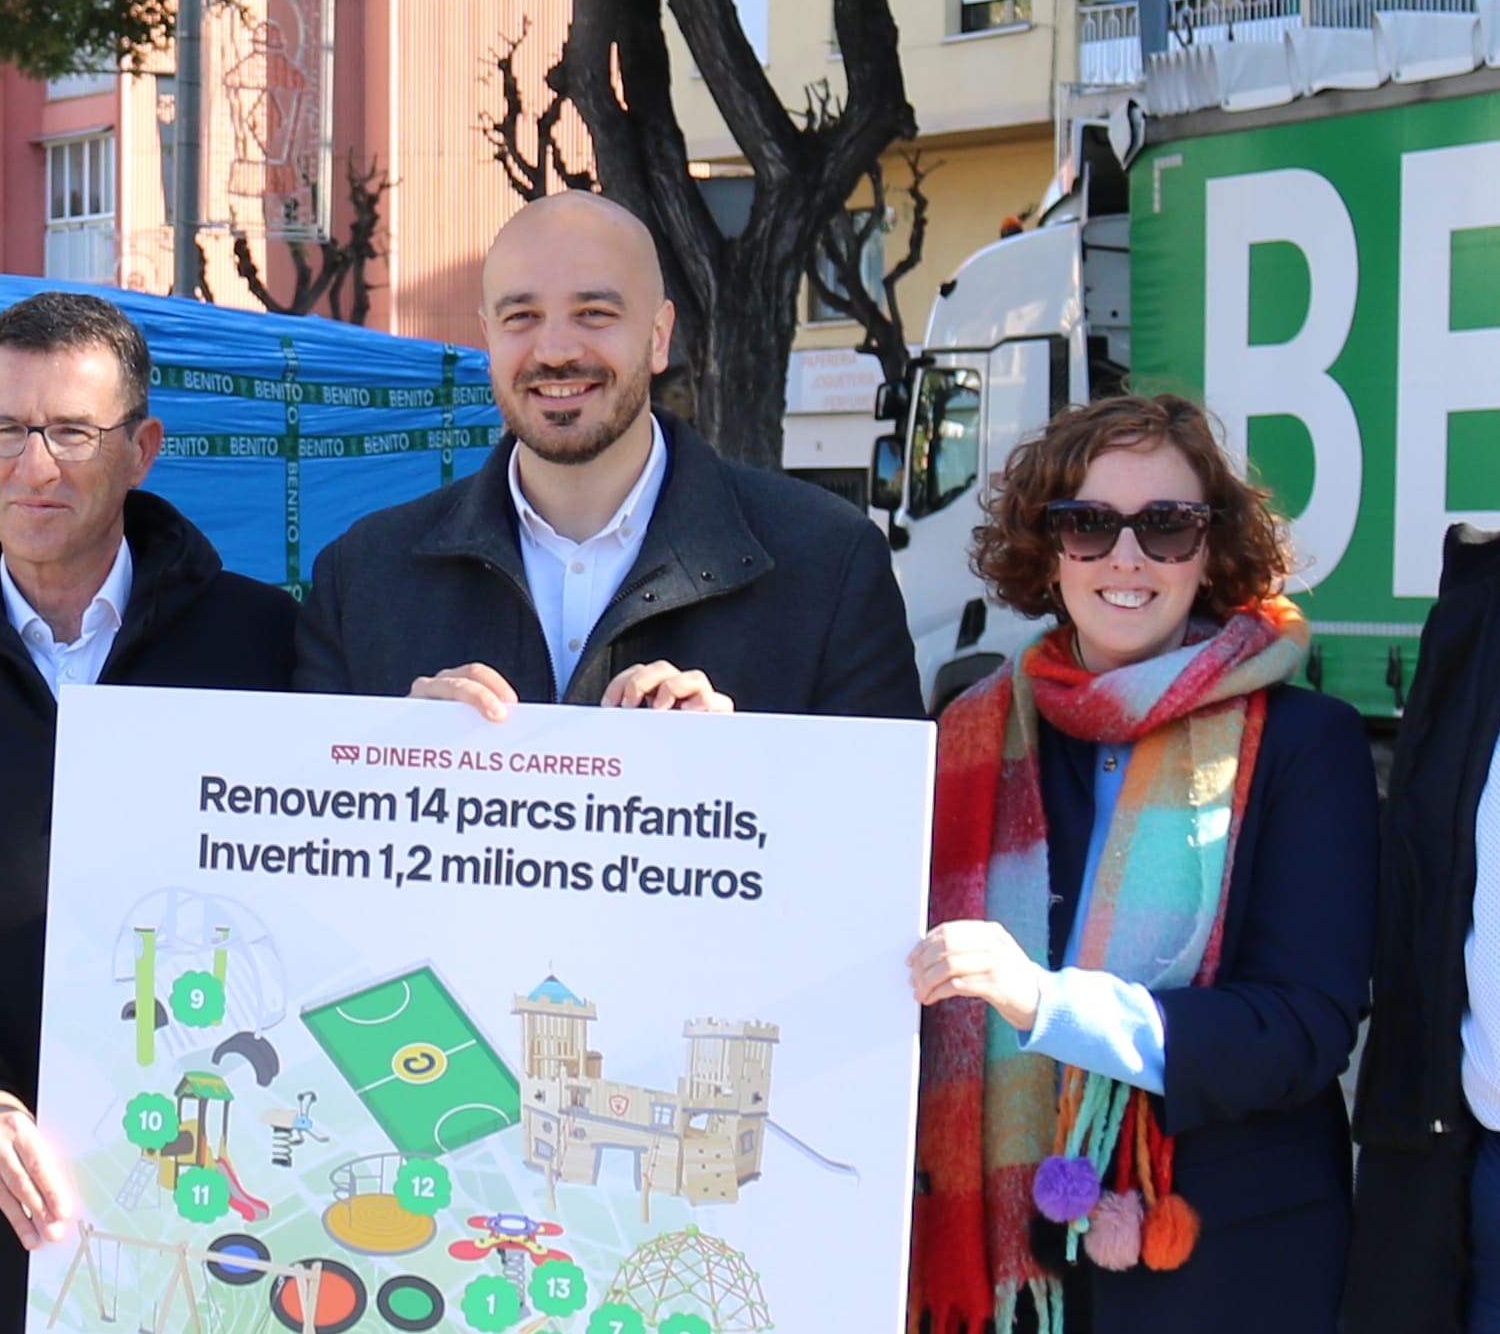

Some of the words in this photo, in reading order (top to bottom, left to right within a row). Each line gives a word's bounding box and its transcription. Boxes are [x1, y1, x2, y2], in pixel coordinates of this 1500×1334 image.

[184, 372, 233, 394] BENITO
[323, 385, 370, 406] BENITO
[389, 389, 434, 407] BENITO
[229, 436, 279, 456] BENITO
[299, 437, 344, 457] BENITO
[364, 434, 410, 454] BENITO
[286, 462, 299, 543] BENITO
[366, 746, 452, 769] DINERS
[458, 751, 503, 771] ALS
[509, 753, 622, 777] CARRERS
[199, 775, 397, 822] Renovem
[405, 786, 449, 824] 14
[456, 796, 576, 834] parcs
[585, 793, 767, 848] infantils,
[199, 832, 370, 878] Invertim
[379, 843, 432, 888] 1,2
[441, 846, 593, 891] milions
[602, 854, 763, 901] d'euros
[190, 989, 204, 1009] 9
[139, 1111, 162, 1131] 10
[192, 1185, 210, 1205] 11
[411, 1176, 436, 1198] 12
[547, 1277, 570, 1299] 13
[486, 1294, 495, 1314] 1
